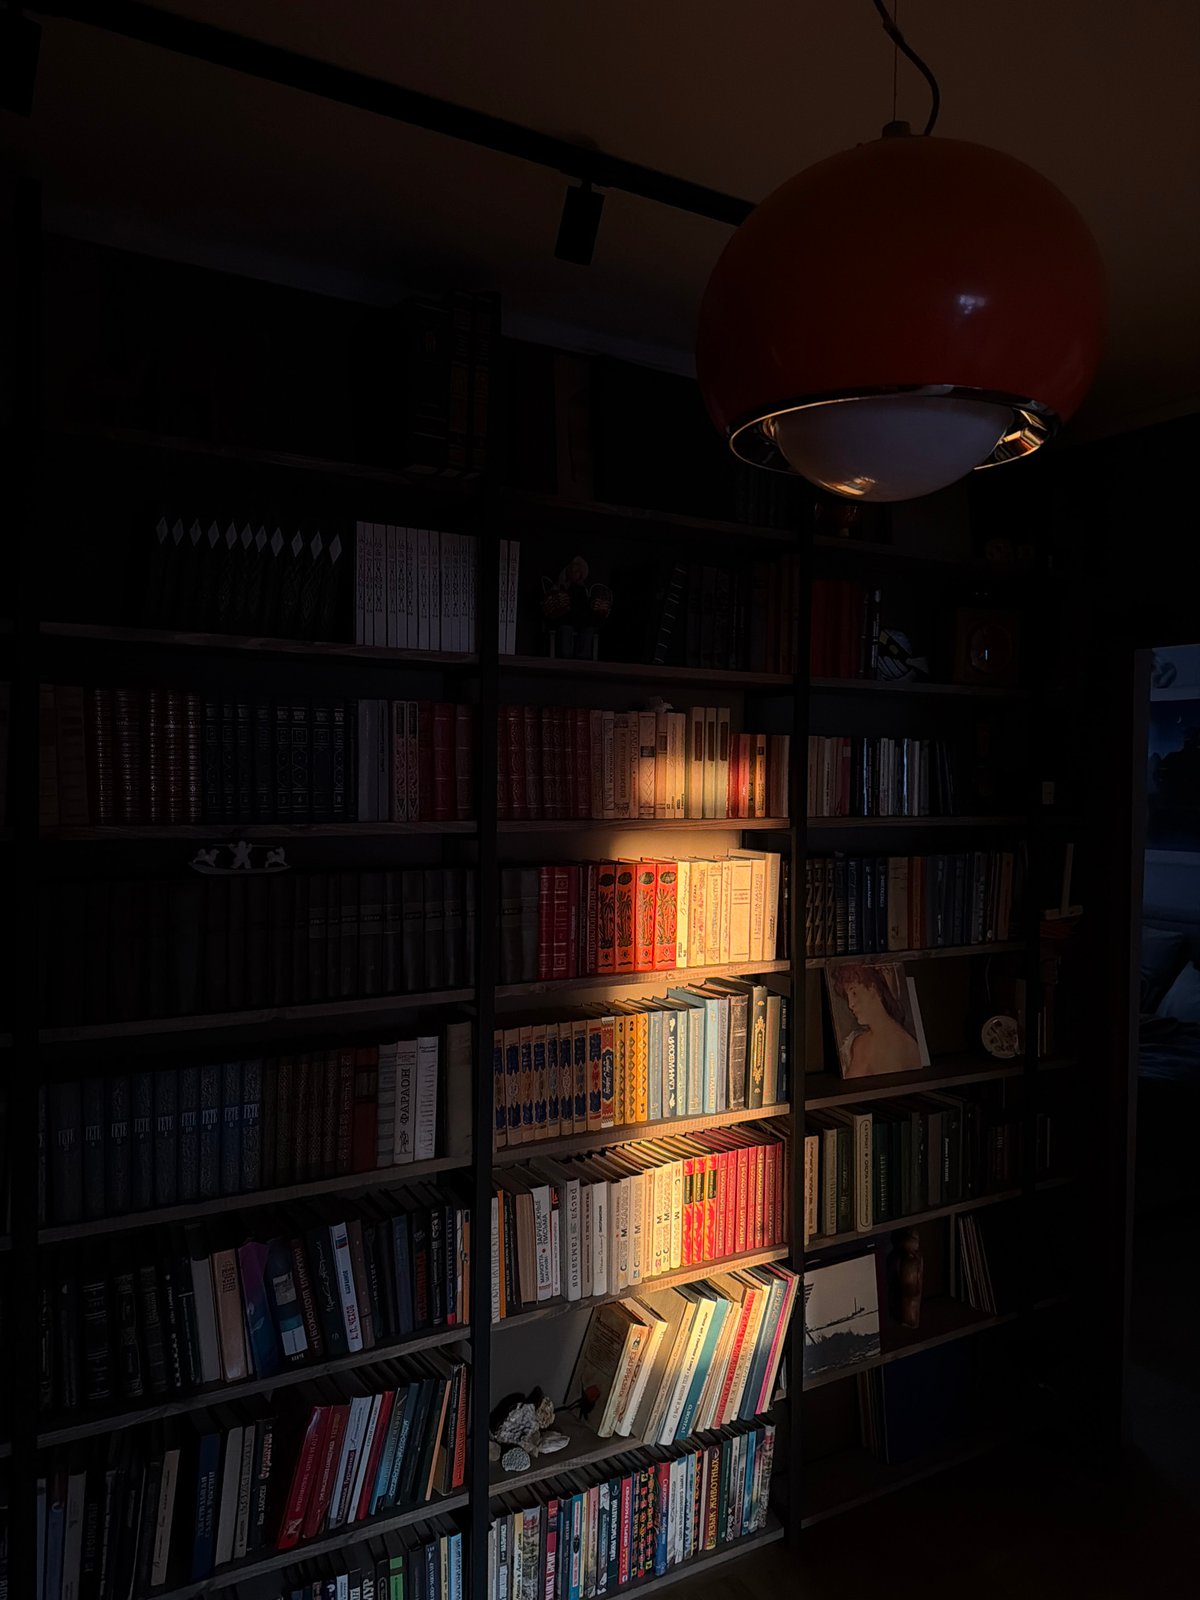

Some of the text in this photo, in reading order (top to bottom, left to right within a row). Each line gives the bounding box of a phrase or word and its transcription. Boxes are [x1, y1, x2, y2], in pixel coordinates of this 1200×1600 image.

[399, 1068, 410, 1123] ФАРАОН
[535, 1200, 543, 1245] ЗАРУБЕЖНЫЕ
[570, 1188, 578, 1219] расул
[345, 1304, 356, 1323] ЧЕХОВ
[707, 1457, 719, 1536] ЯЗЫК ЖИВОТНЫХ
[610, 1498, 618, 1538] ТЫСЯЧЕЛЕТИЙ
